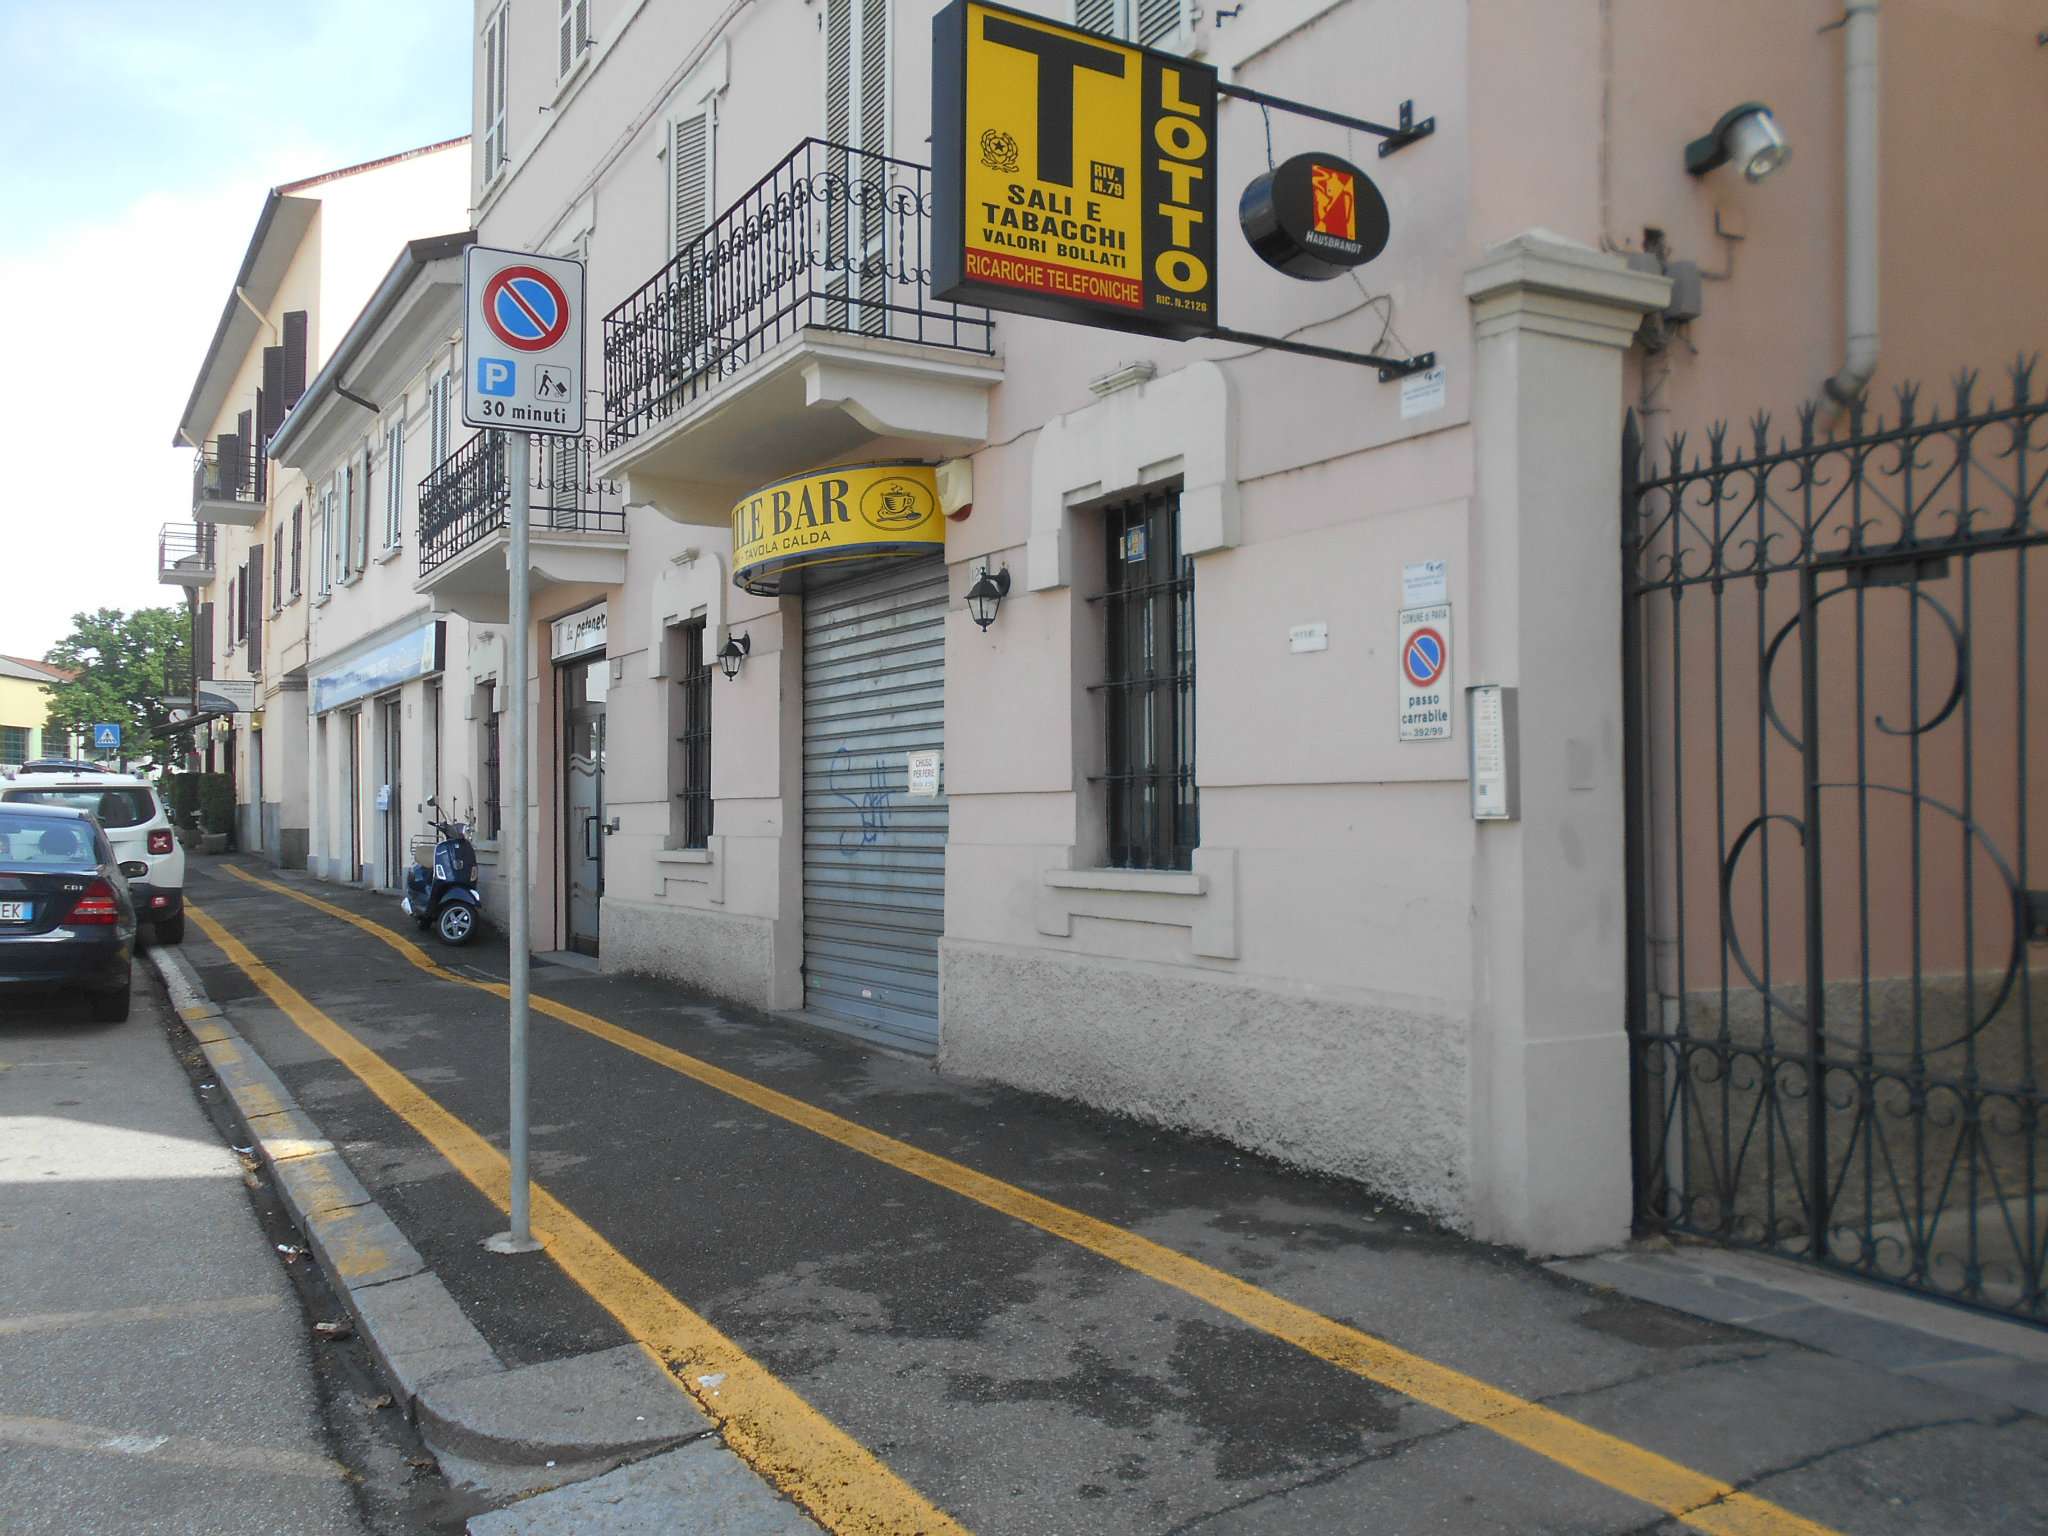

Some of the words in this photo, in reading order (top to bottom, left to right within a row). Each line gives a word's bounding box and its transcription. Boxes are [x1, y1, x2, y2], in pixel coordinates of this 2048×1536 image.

[983, 15, 1125, 188] T
[1094, 164, 1119, 181] RIV.
[1094, 179, 1123, 196] N.79
[1154, 68, 1208, 293] LOTTO
[1008, 184, 1072, 216] SALI
[1087, 201, 1101, 222] E
[982, 202, 1126, 250] TABACCHI
[983, 228, 1046, 254] VALORI
[1057, 243, 1126, 269] BOLLATI
[966, 254, 1044, 286] RICARICHE
[1047, 269, 1139, 303] TELEFONICHE
[485, 363, 509, 391] P
[483, 400, 505, 417] 30
[512, 405, 566, 424] minuti
[771, 479, 852, 536] BAR
[744, 542, 778, 559] TAVOLA
[783, 530, 831, 549] CALDA
[1402, 709, 1448, 724] carrabile
[1409, 695, 1440, 709] passo
